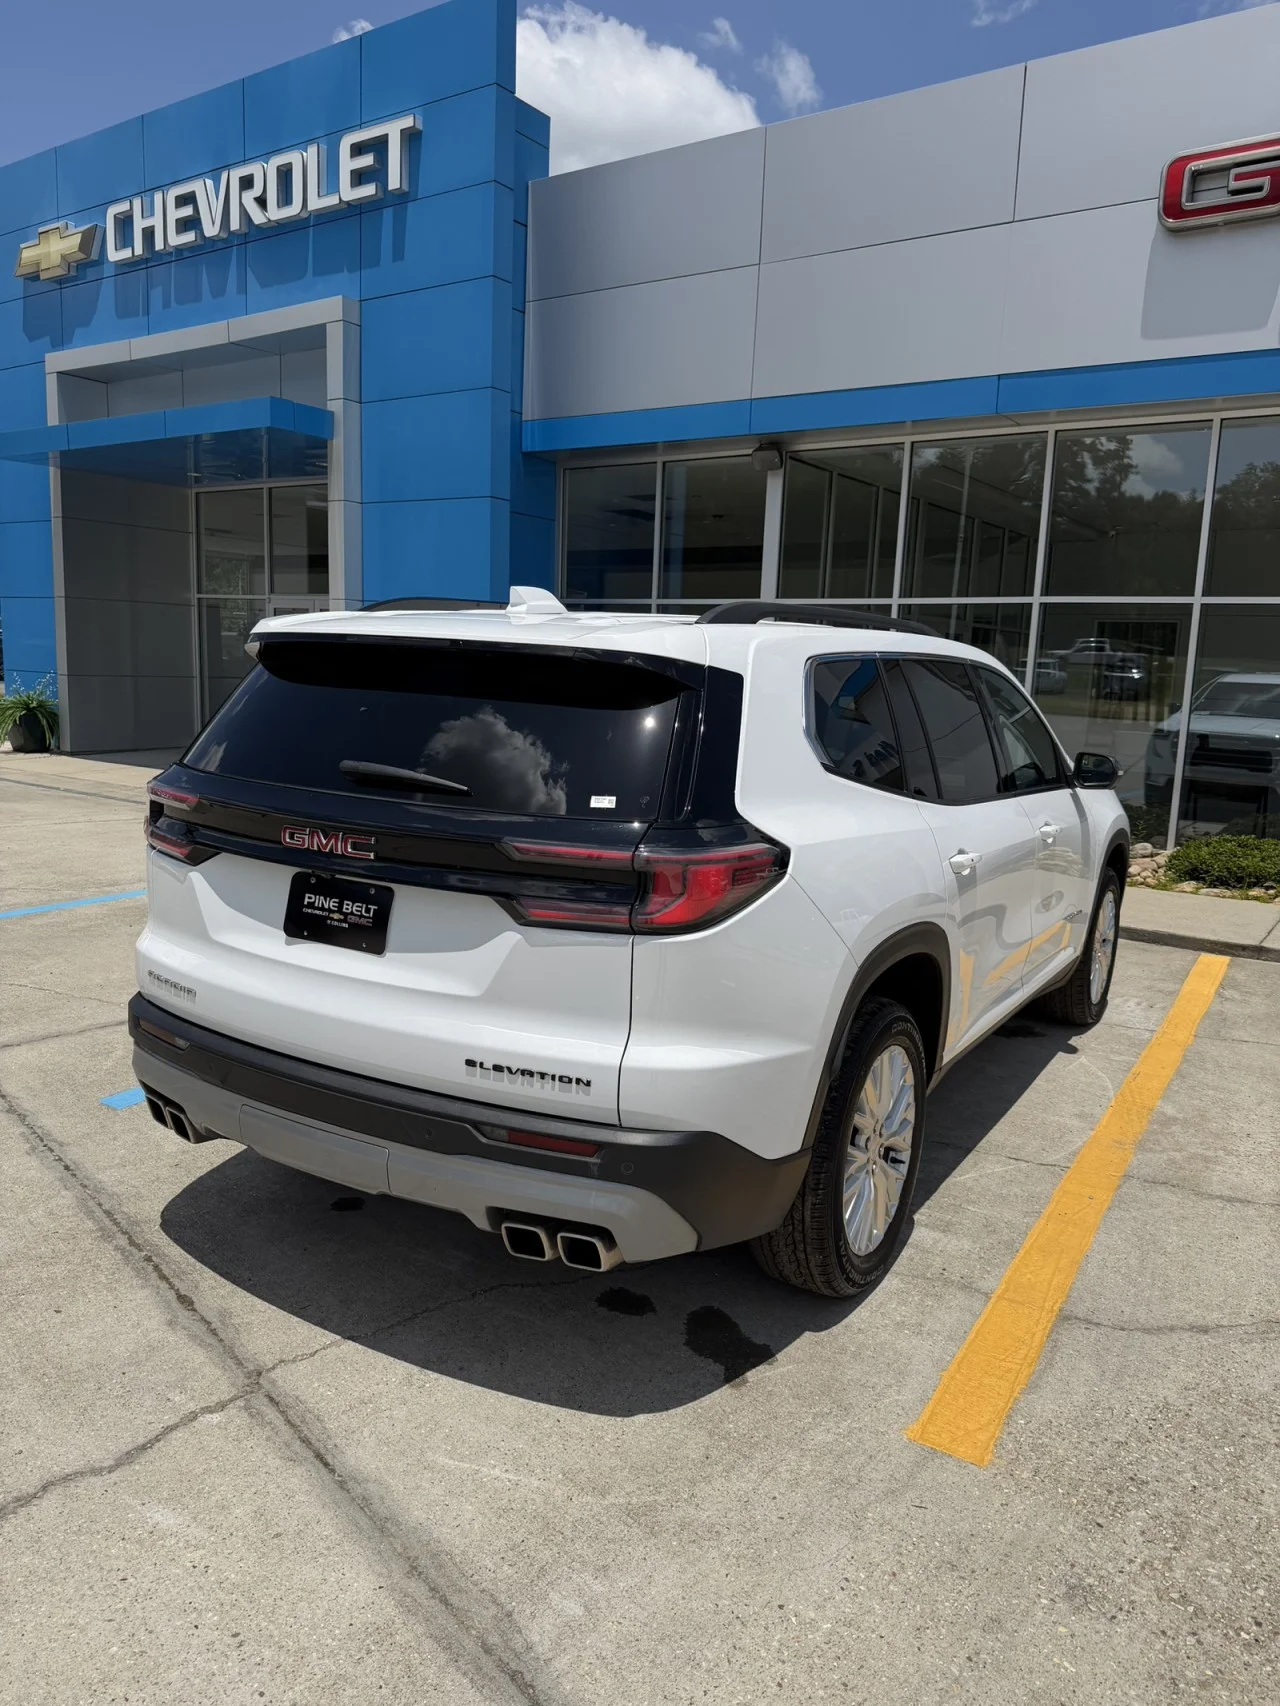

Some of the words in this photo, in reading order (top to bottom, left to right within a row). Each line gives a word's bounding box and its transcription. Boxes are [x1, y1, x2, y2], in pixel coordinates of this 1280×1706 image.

[106, 114, 422, 264] CHEVROLET
[281, 824, 376, 859] GMC
[302, 907, 329, 916] CHEVROLET
[346, 914, 373, 927] GMC
[304, 893, 340, 911] PINE
[342, 900, 378, 917] BELT
[465, 1058, 592, 1087] ELEVATION
